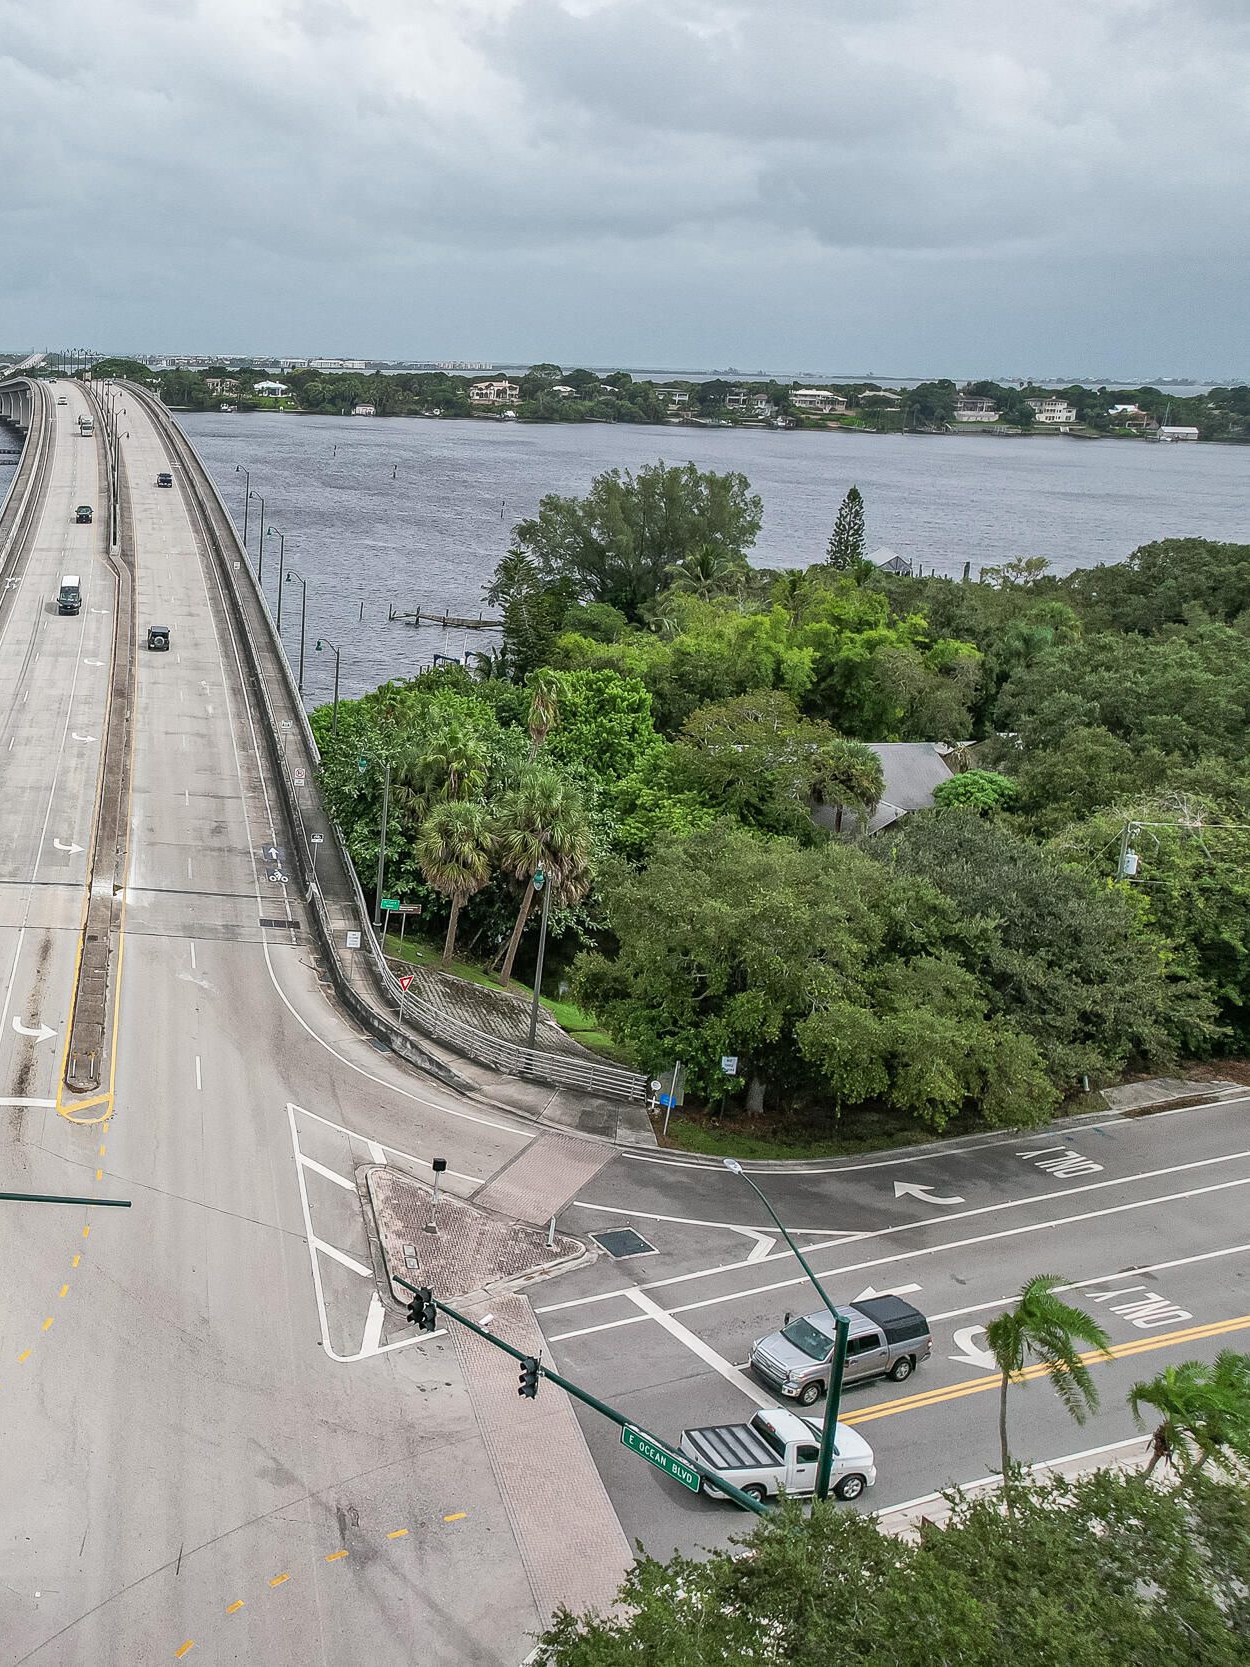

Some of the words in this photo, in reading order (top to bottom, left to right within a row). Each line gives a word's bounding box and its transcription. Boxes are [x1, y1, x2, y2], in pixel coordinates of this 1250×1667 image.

[1015, 1145, 1104, 1179] ONLY
[1084, 1285, 1194, 1329] ONLY
[628, 1434, 635, 1445] E
[639, 1442, 667, 1467] OCEAN
[672, 1463, 693, 1484] BLVD
